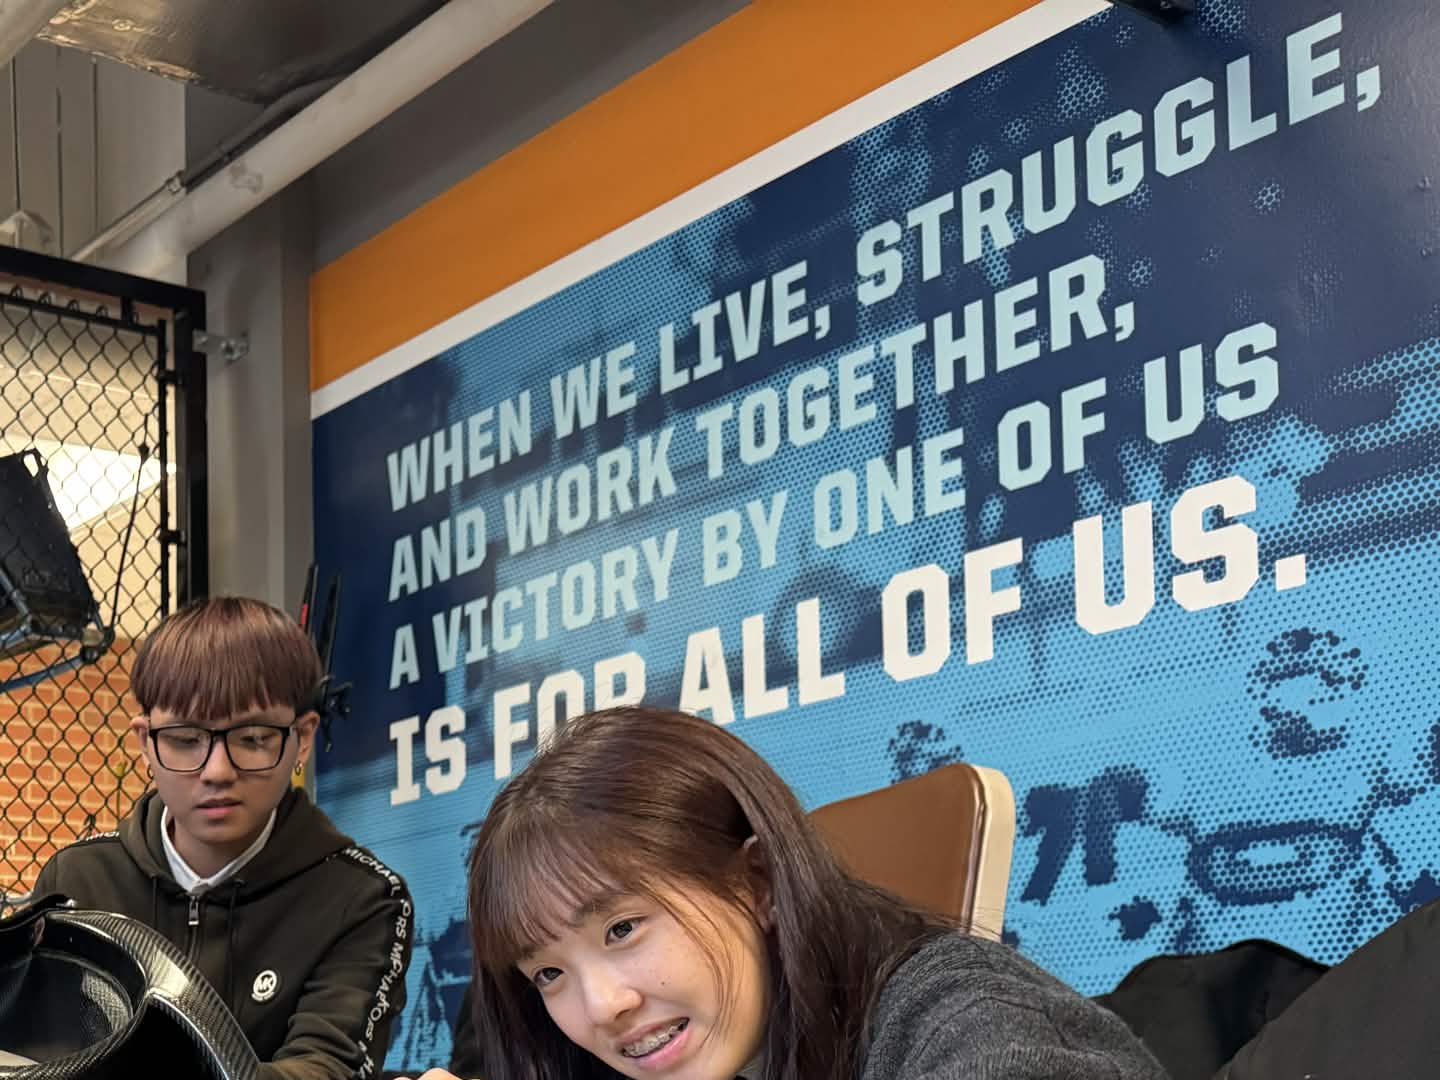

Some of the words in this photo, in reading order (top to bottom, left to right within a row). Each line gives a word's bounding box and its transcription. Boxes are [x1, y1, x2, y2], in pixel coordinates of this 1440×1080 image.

[387, 390, 532, 511] WHEN
[550, 341, 638, 439] WE
[659, 260, 831, 394] LIVE,
[857, 12, 1382, 306] STRUGGLE,
[389, 506, 487, 602] AND
[503, 426, 678, 556] WORK
[695, 254, 1135, 481] TOGETHER,
[389, 625, 420, 690] A
[432, 526, 683, 673] VICTORY
[701, 488, 790, 588] BY
[813, 427, 966, 551] ONE
[997, 377, 1107, 491] OF
[1143, 321, 1279, 445] US
[389, 703, 467, 806] IS
[678, 596, 847, 728] ALL
[880, 537, 1024, 684] OF
[1072, 473, 1310, 637] US.
